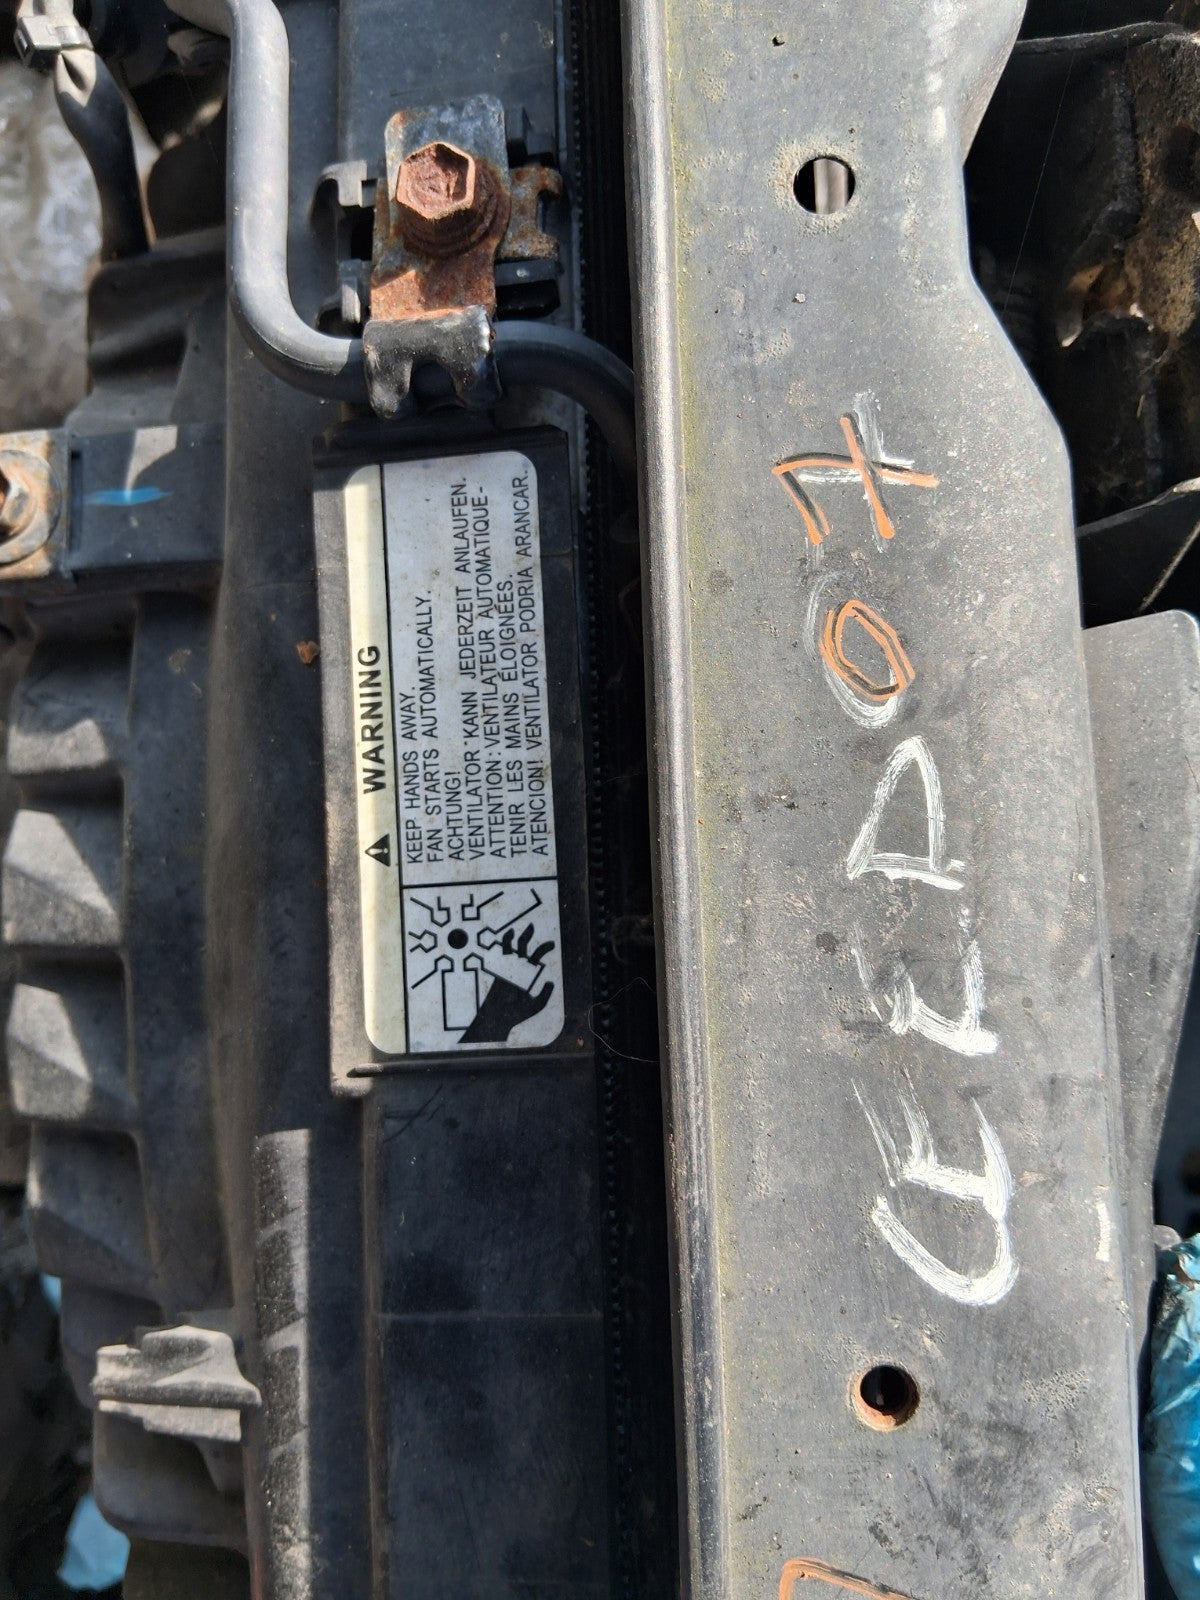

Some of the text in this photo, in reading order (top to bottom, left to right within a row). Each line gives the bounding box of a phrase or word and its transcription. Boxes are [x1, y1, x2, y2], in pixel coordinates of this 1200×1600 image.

[358, 646, 386, 794] WARNING
[400, 687, 423, 864] KEEP HANDS AWAY.
[416, 591, 443, 862] FAN STARTS AUTOMATICALLY.
[451, 478, 485, 860] VENTILATOR KANN JEDERZEIT ANLAUFEN.
[478, 629, 500, 748] VENTILATEUR
[494, 575, 527, 858] TENIR LES MAINS ÉLOIGNÉES.
[512, 471, 548, 856] ATENCION! VENTILATOR PODRIA ARANCAR.
[445, 771, 464, 861] ACHTUNG!
